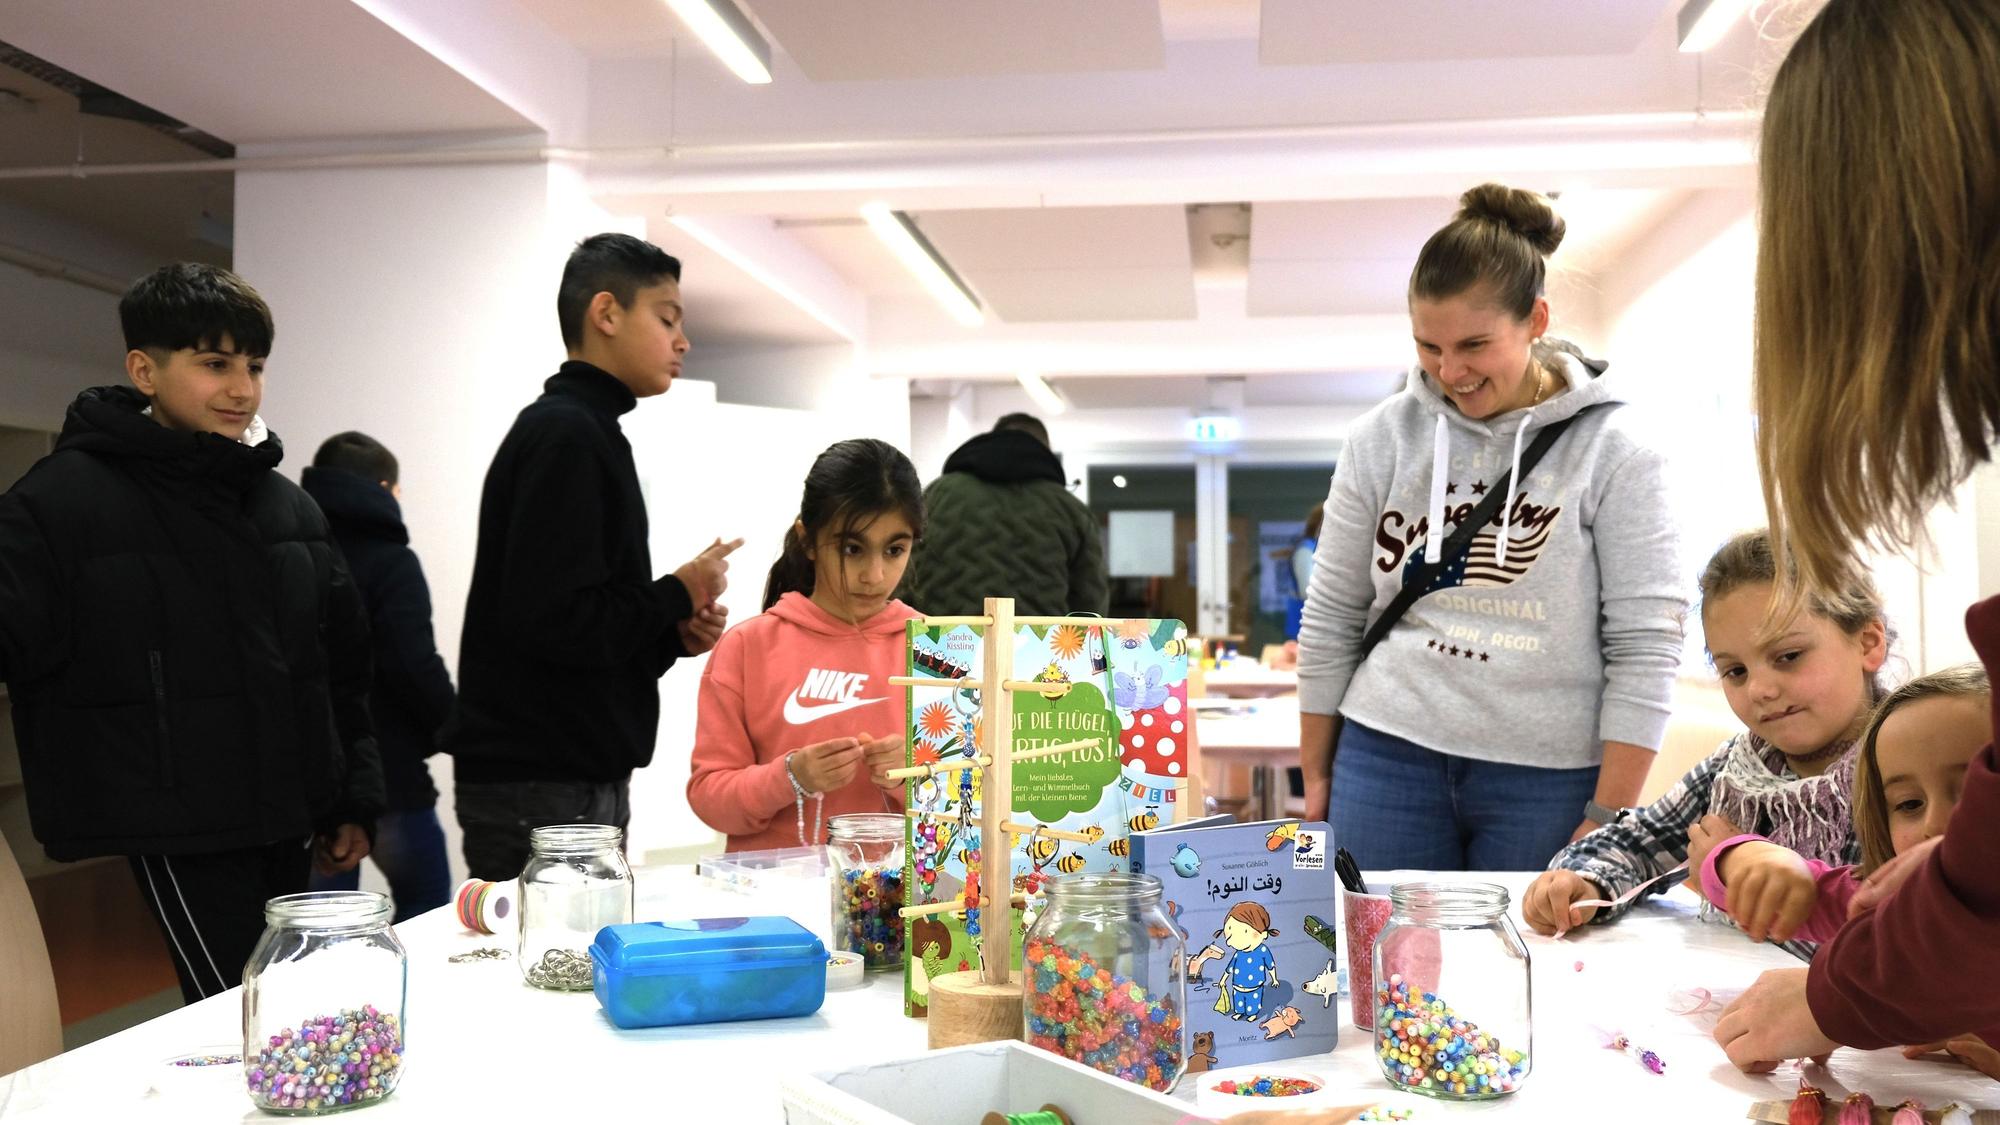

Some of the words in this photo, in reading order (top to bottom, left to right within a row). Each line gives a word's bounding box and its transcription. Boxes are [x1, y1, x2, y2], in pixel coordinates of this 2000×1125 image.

[1435, 592, 1546, 621] ORIGINAL
[947, 632, 973, 641] Sandra
[947, 642, 975, 651] Kissling
[799, 668, 870, 703] NIKE
[1031, 712, 1053, 729] DIE
[1058, 709, 1110, 736] FLÜGEL,
[1072, 737, 1113, 762] LOS!
[1029, 773, 1046, 781] Mein
[1047, 773, 1074, 781] liebstes
[1033, 783, 1046, 791] und
[1047, 783, 1090, 791] Wimmelbuch
[1120, 777, 1174, 801] ZIEL
[1016, 793, 1027, 801] mit
[1028, 793, 1040, 801] der
[1041, 793, 1067, 801] kleinen
[1068, 793, 1088, 801] Biene
[1222, 863, 1245, 871] Susanne
[1295, 854, 1323, 864] Vorlesen
[1207, 876, 1248, 903] النوم!
[1253, 873, 1282, 895] وقت
